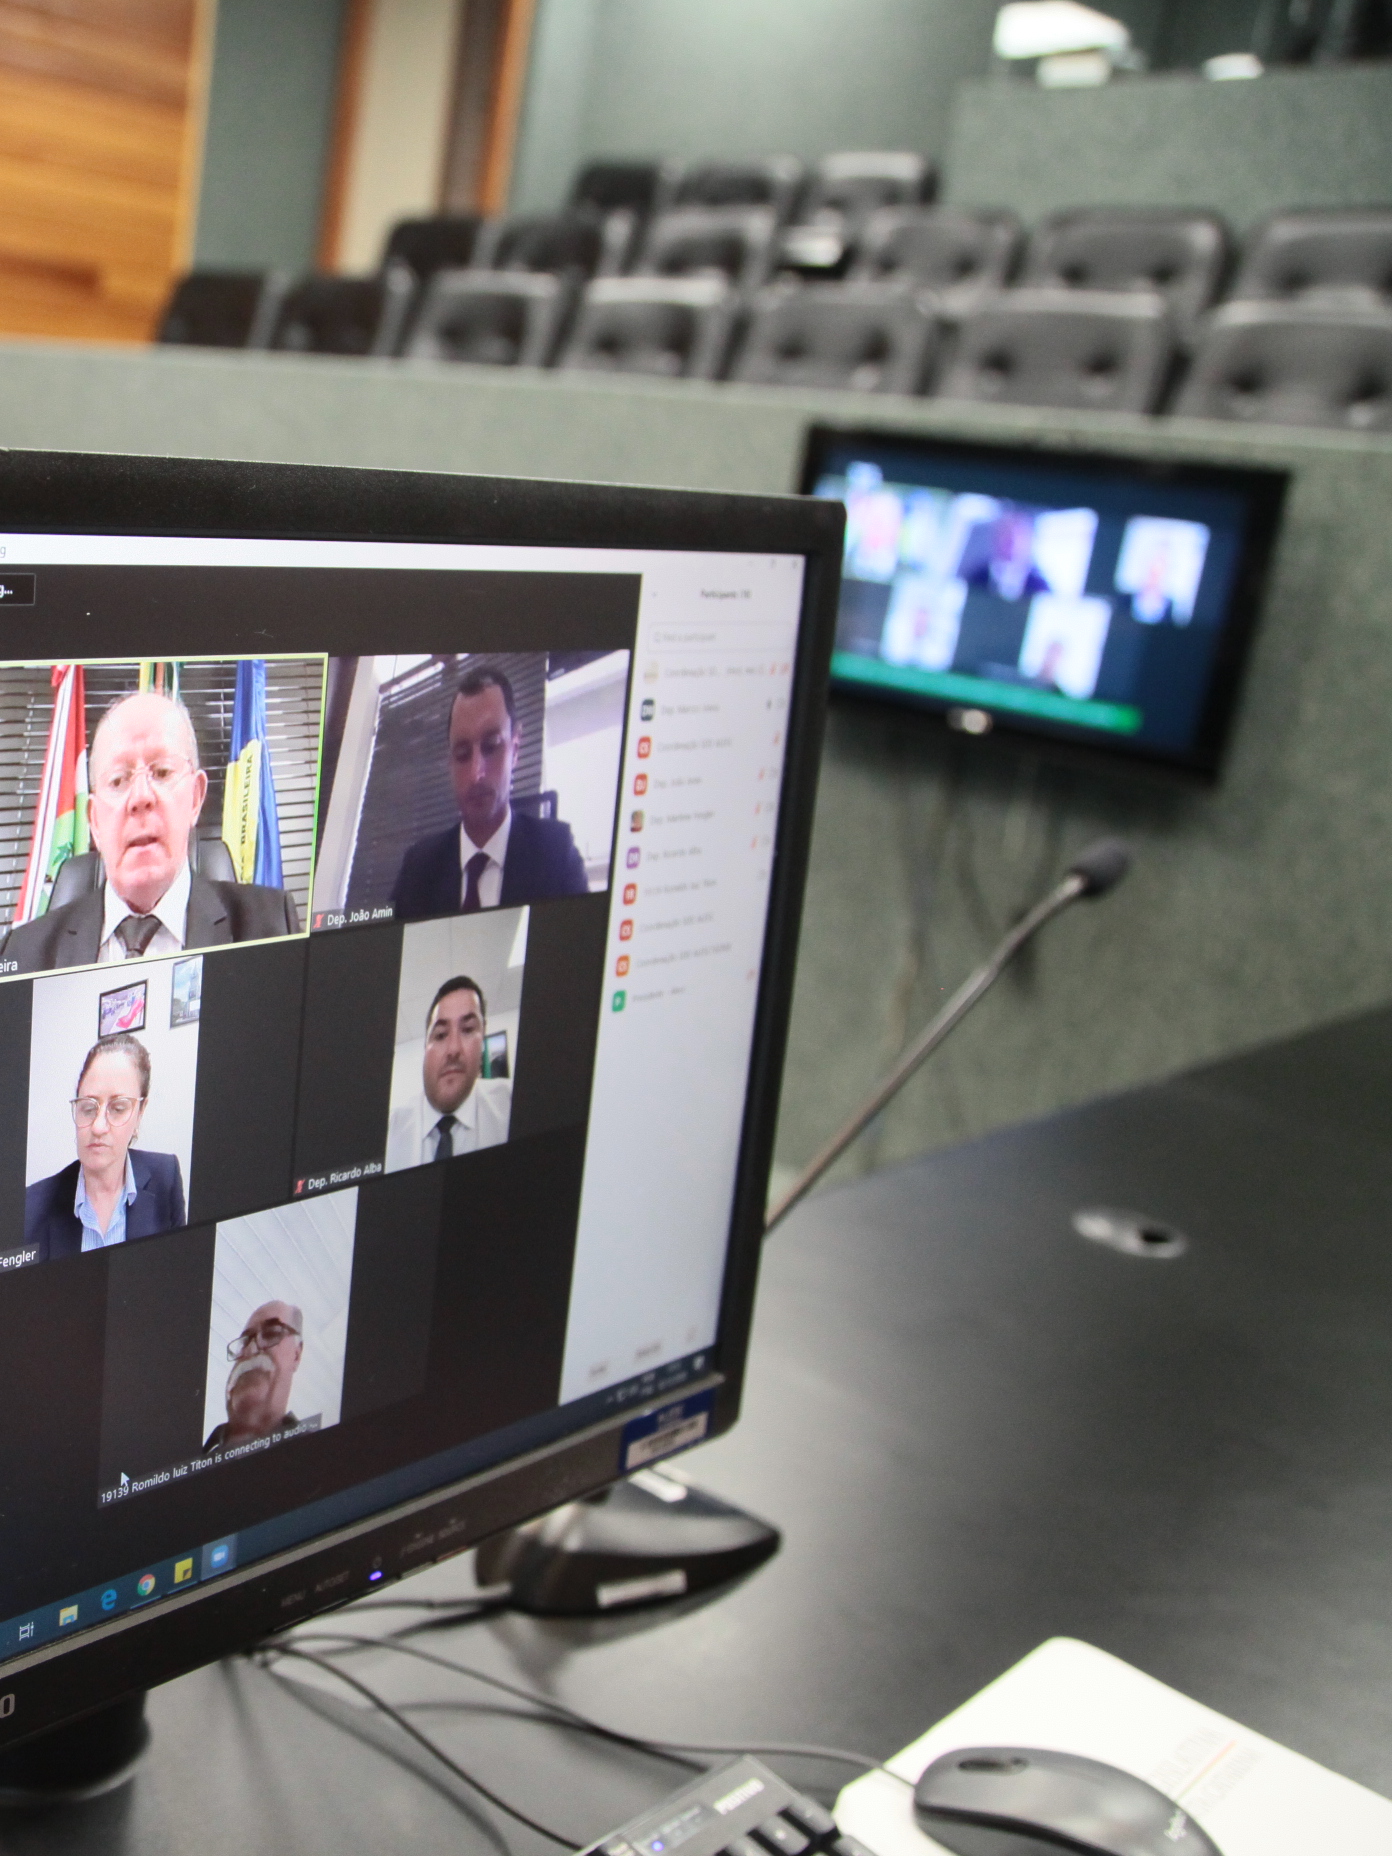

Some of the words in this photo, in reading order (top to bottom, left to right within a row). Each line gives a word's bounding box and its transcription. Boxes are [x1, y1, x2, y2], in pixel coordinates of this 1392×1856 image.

[327, 913, 348, 928] Dep.
[349, 908, 370, 923] João
[371, 905, 393, 920] Amin
[308, 1177, 328, 1190] Dep.
[330, 1166, 362, 1184] Ricardo
[363, 1162, 382, 1176] Alba
[101, 1484, 130, 1503] 19139
[131, 1471, 171, 1493] Romildo
[173, 1464, 188, 1478] luiz
[190, 1457, 213, 1472] Titon
[214, 1452, 222, 1464] is
[224, 1436, 271, 1460] connecting
[272, 1433, 282, 1443] to
